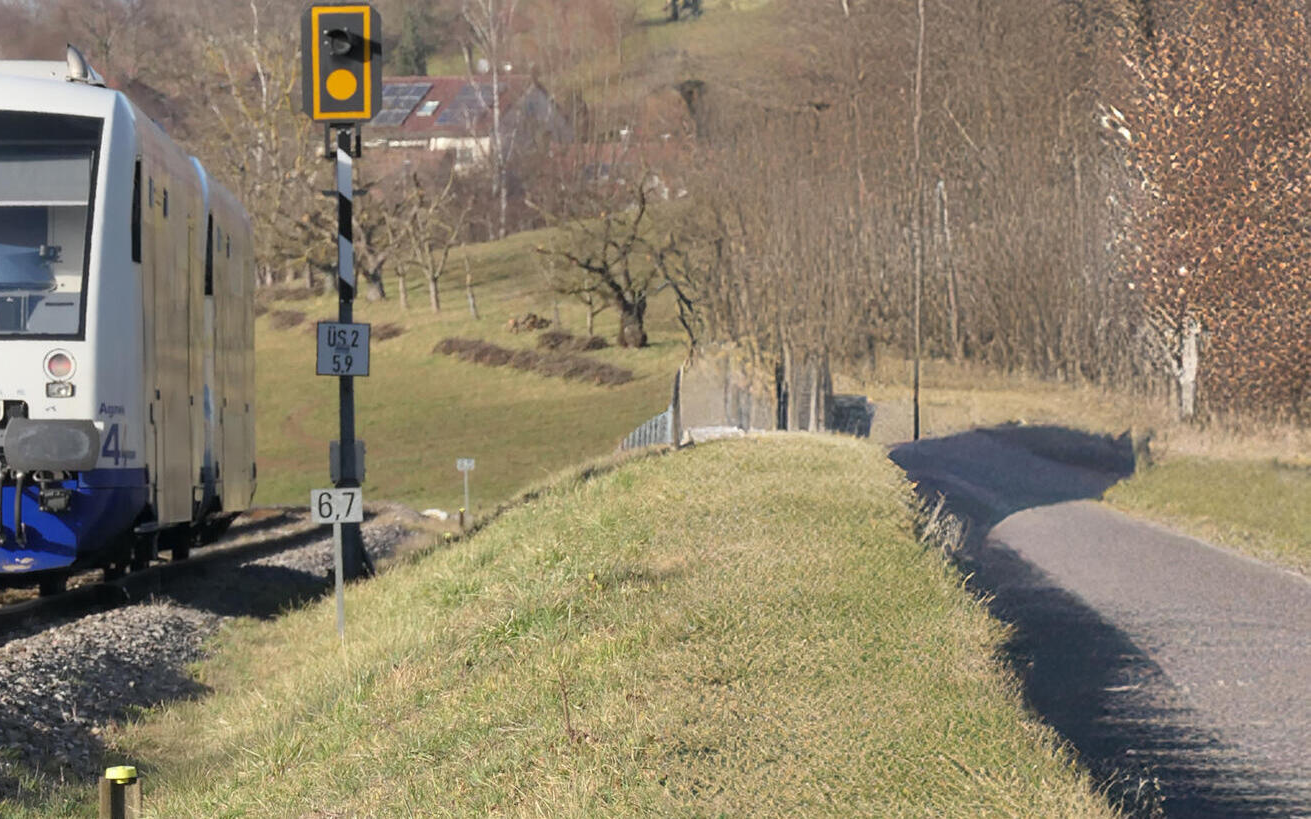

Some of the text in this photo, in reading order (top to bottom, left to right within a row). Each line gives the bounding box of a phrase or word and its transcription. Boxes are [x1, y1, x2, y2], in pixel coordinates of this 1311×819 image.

[327, 326, 359, 348] ÜS 2
[101, 423, 120, 466] 4
[318, 492, 355, 521] 6,7
